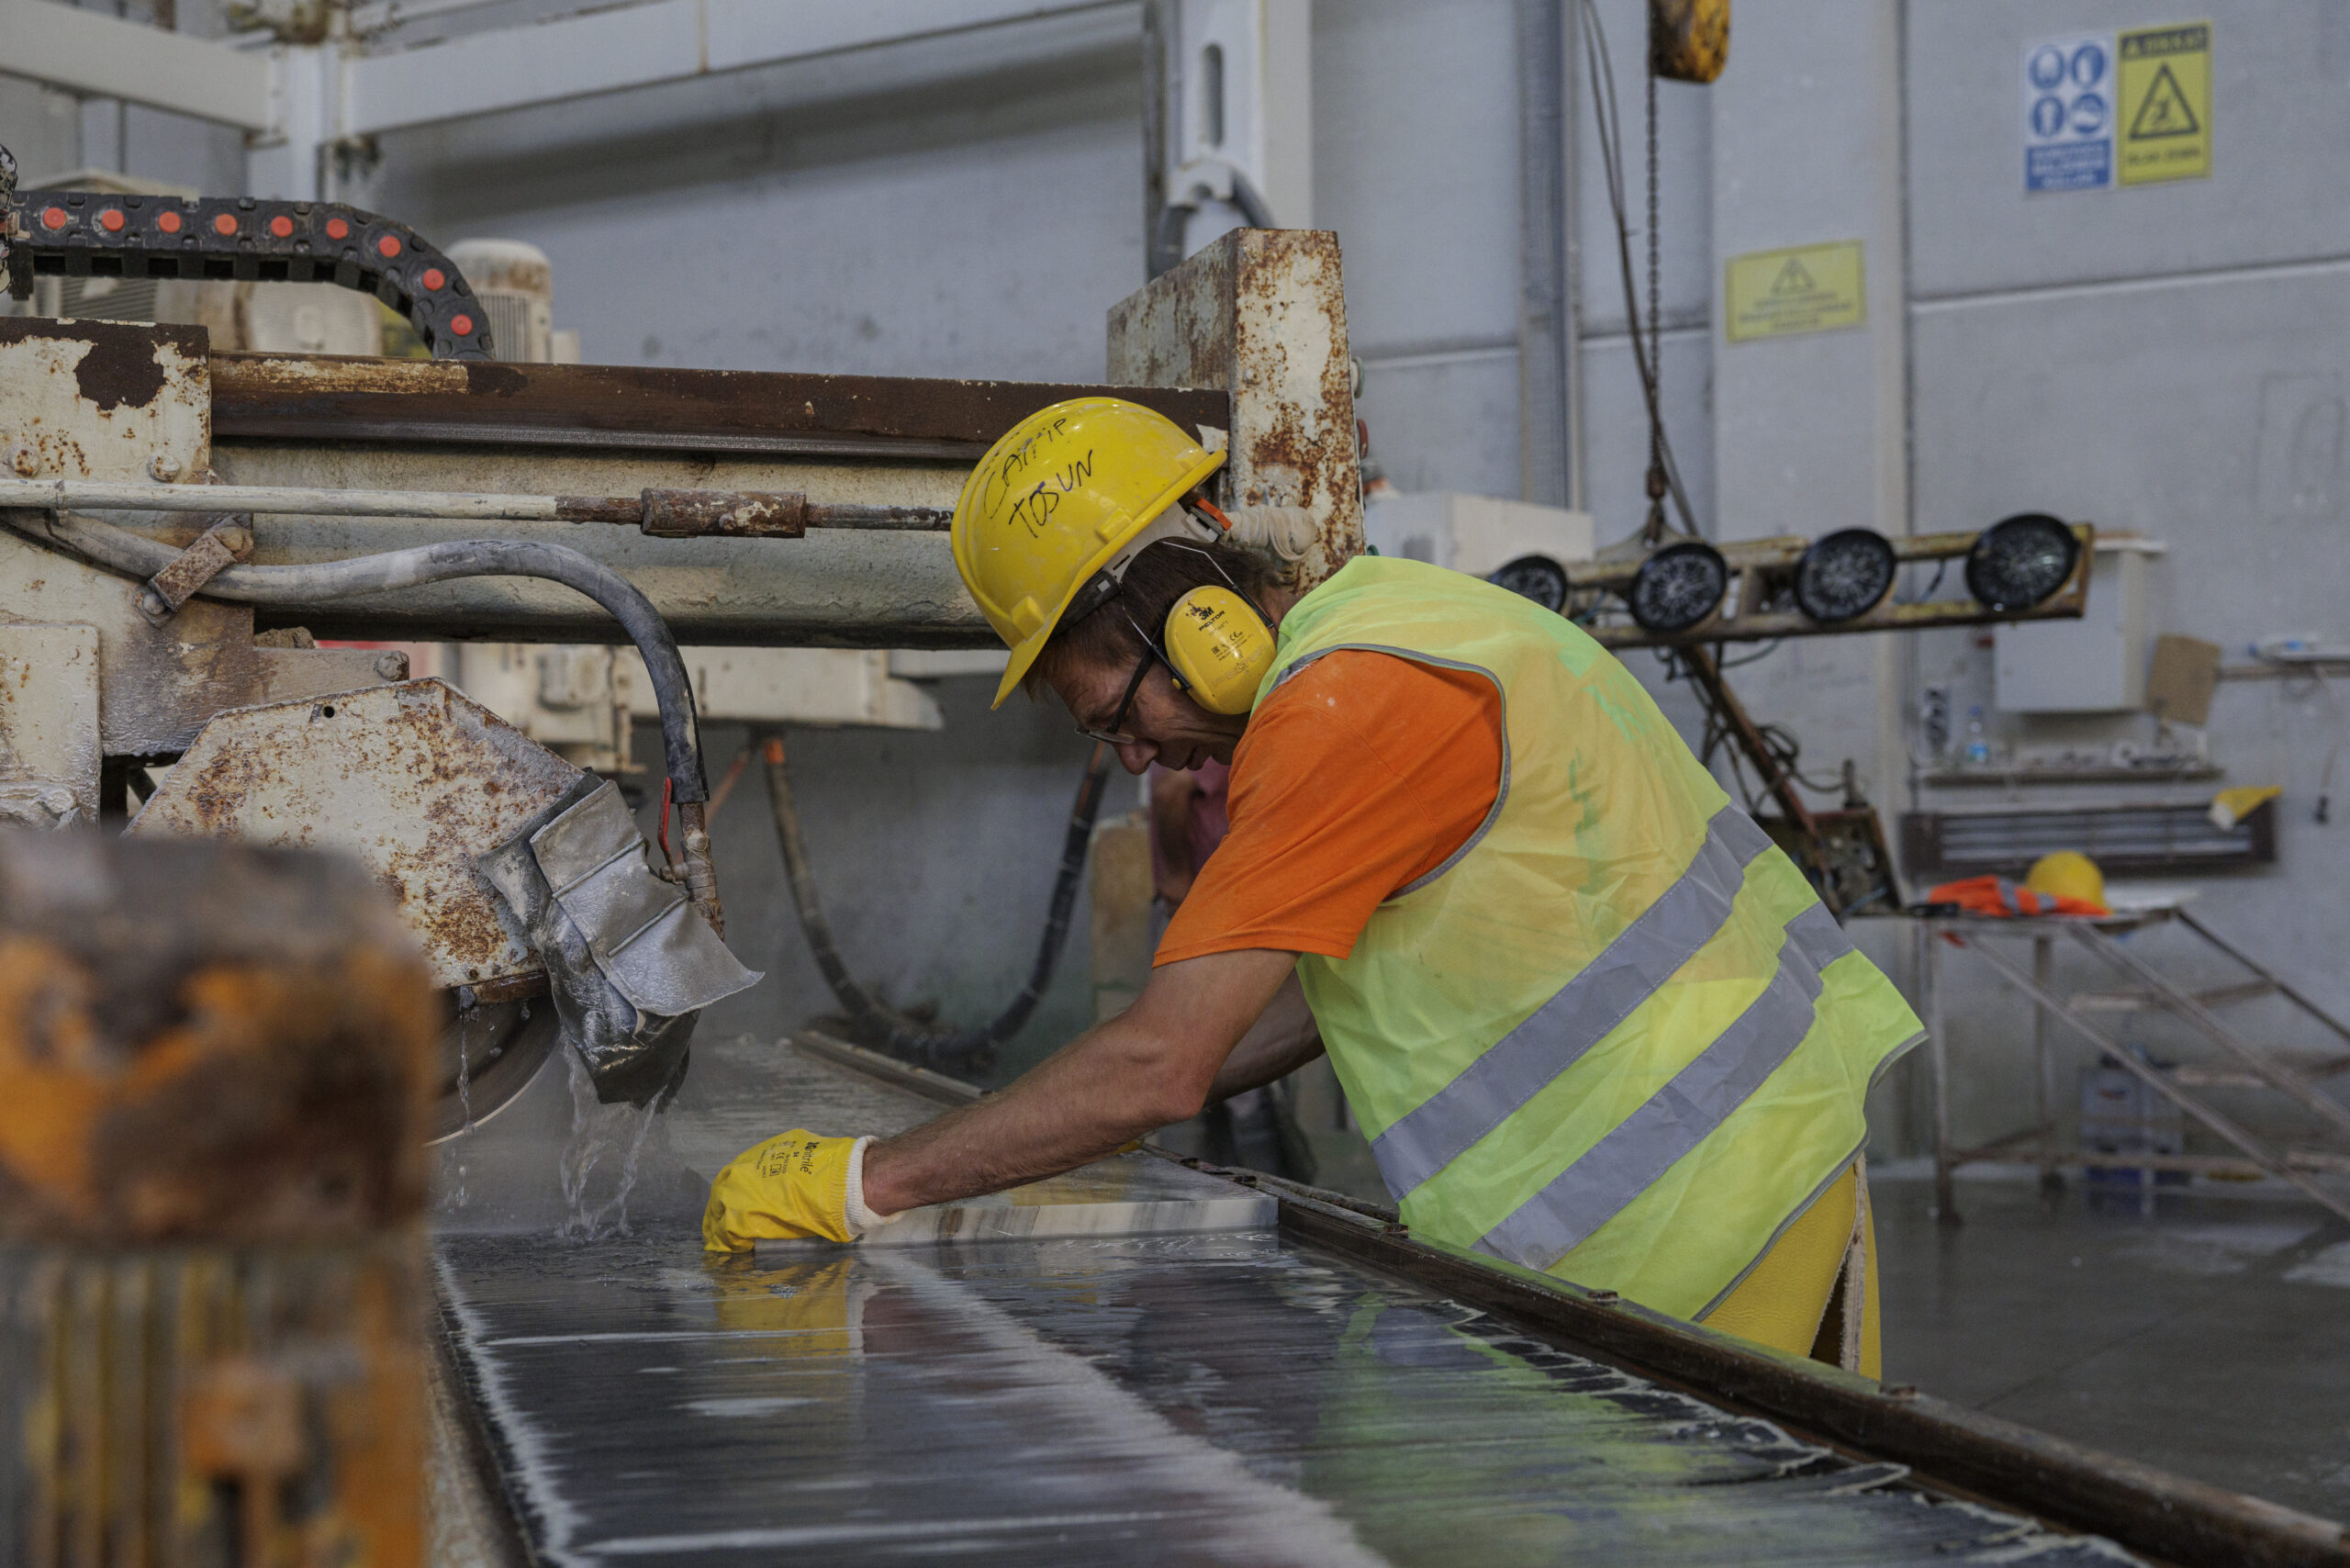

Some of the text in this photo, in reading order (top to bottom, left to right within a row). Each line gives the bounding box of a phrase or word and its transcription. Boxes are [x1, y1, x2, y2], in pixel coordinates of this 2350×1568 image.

[1009, 449, 1093, 539] TOSUN
[1198, 606, 1214, 621] 3M
[1198, 610, 1225, 632] PELTOR
